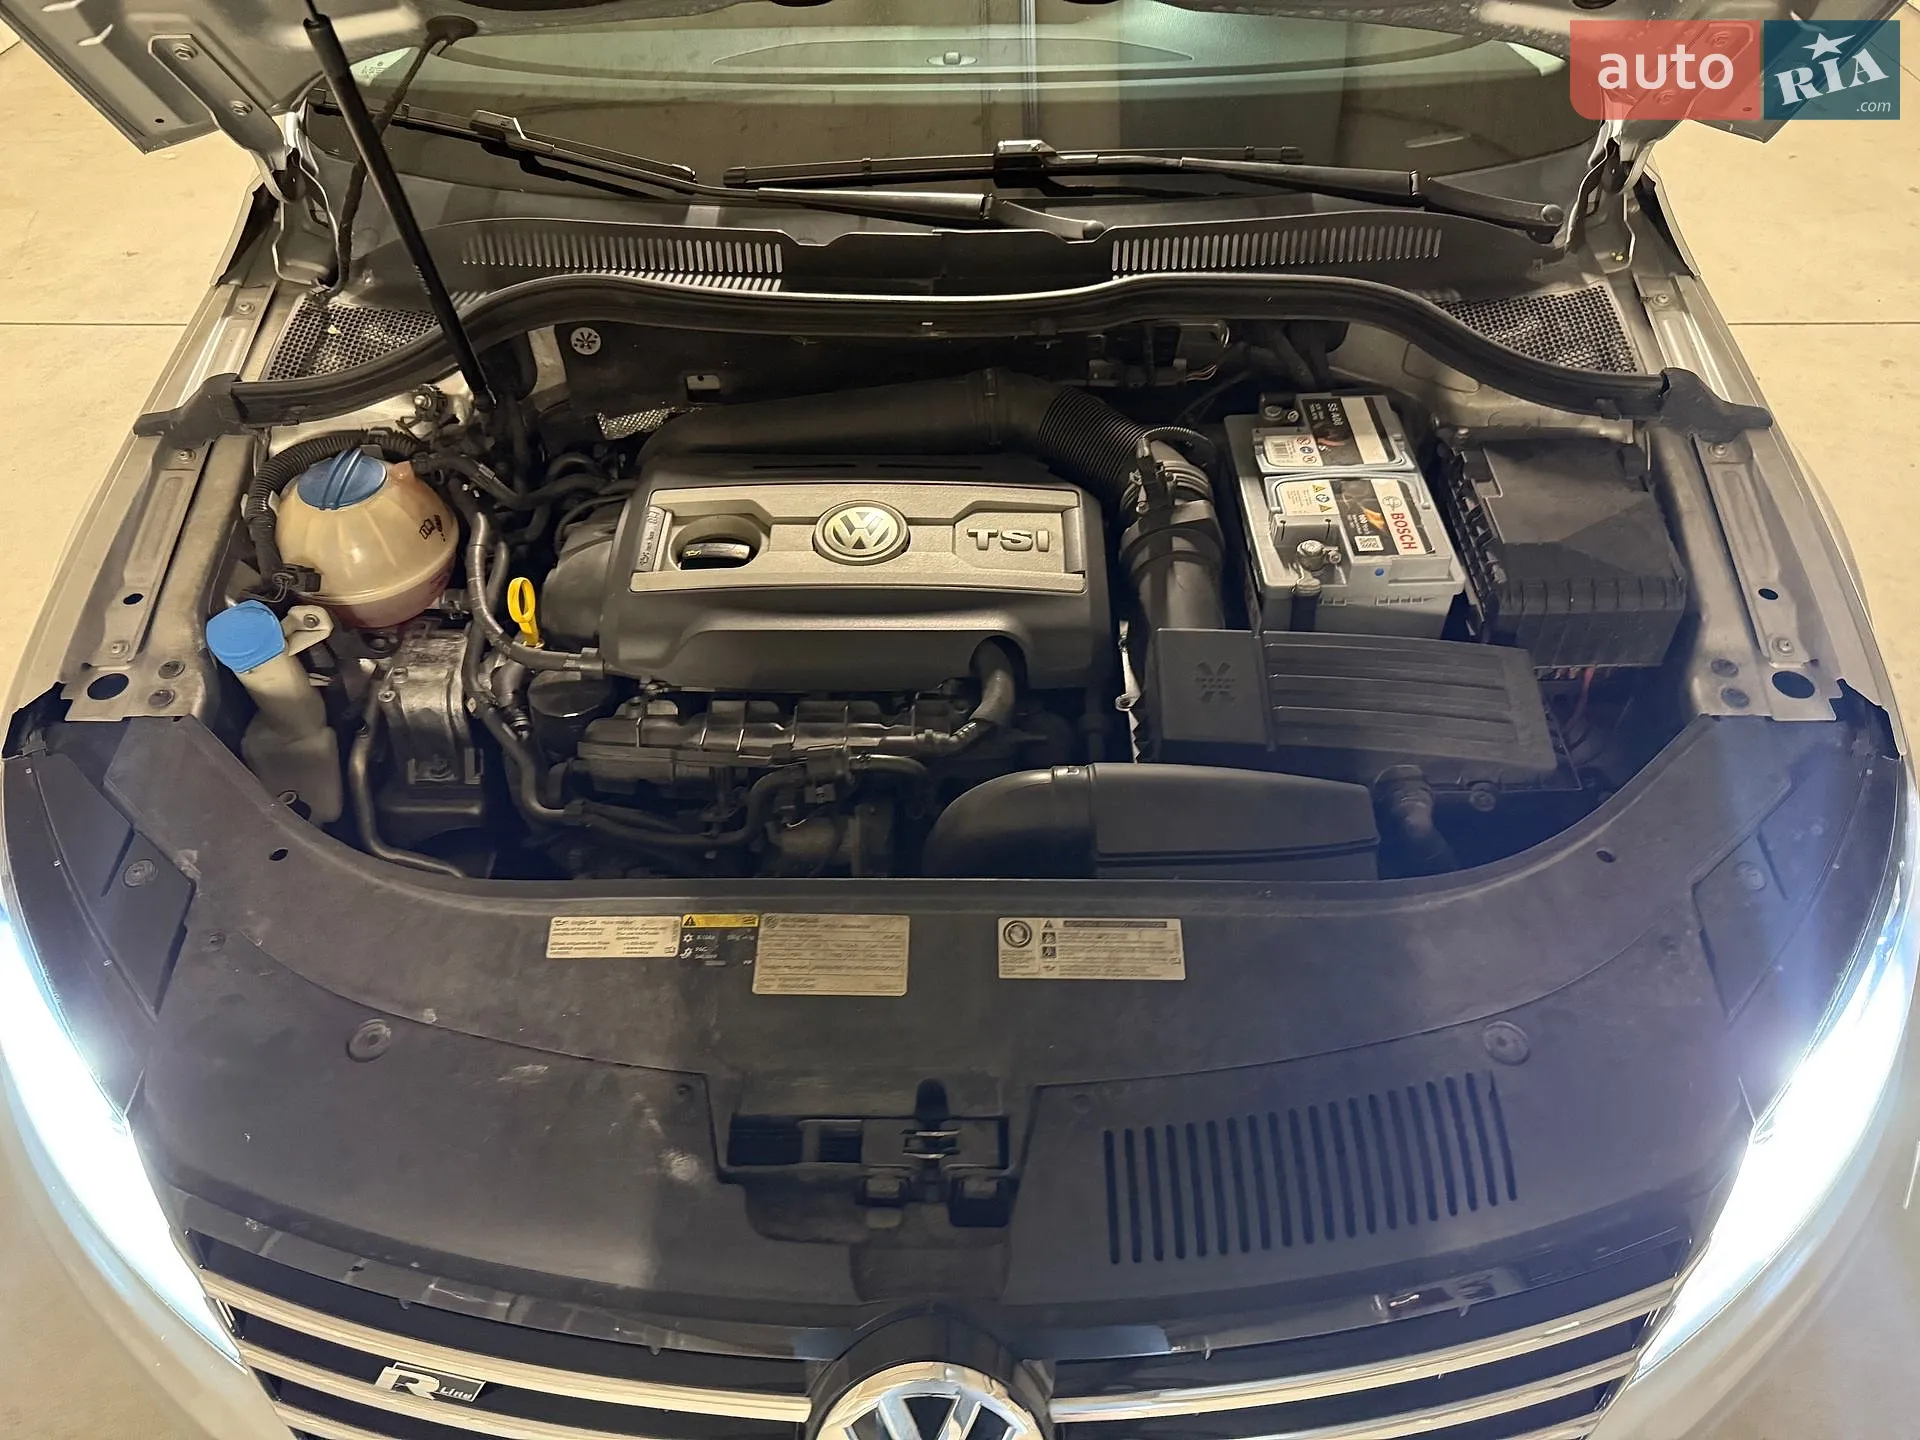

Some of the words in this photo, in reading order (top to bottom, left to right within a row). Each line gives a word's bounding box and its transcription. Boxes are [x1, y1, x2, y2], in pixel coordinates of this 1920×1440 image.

[828, 506, 894, 552] VW
[967, 527, 1050, 553] TSI
[1391, 512, 1418, 550] BOSCH
[374, 1366, 440, 1401] R
